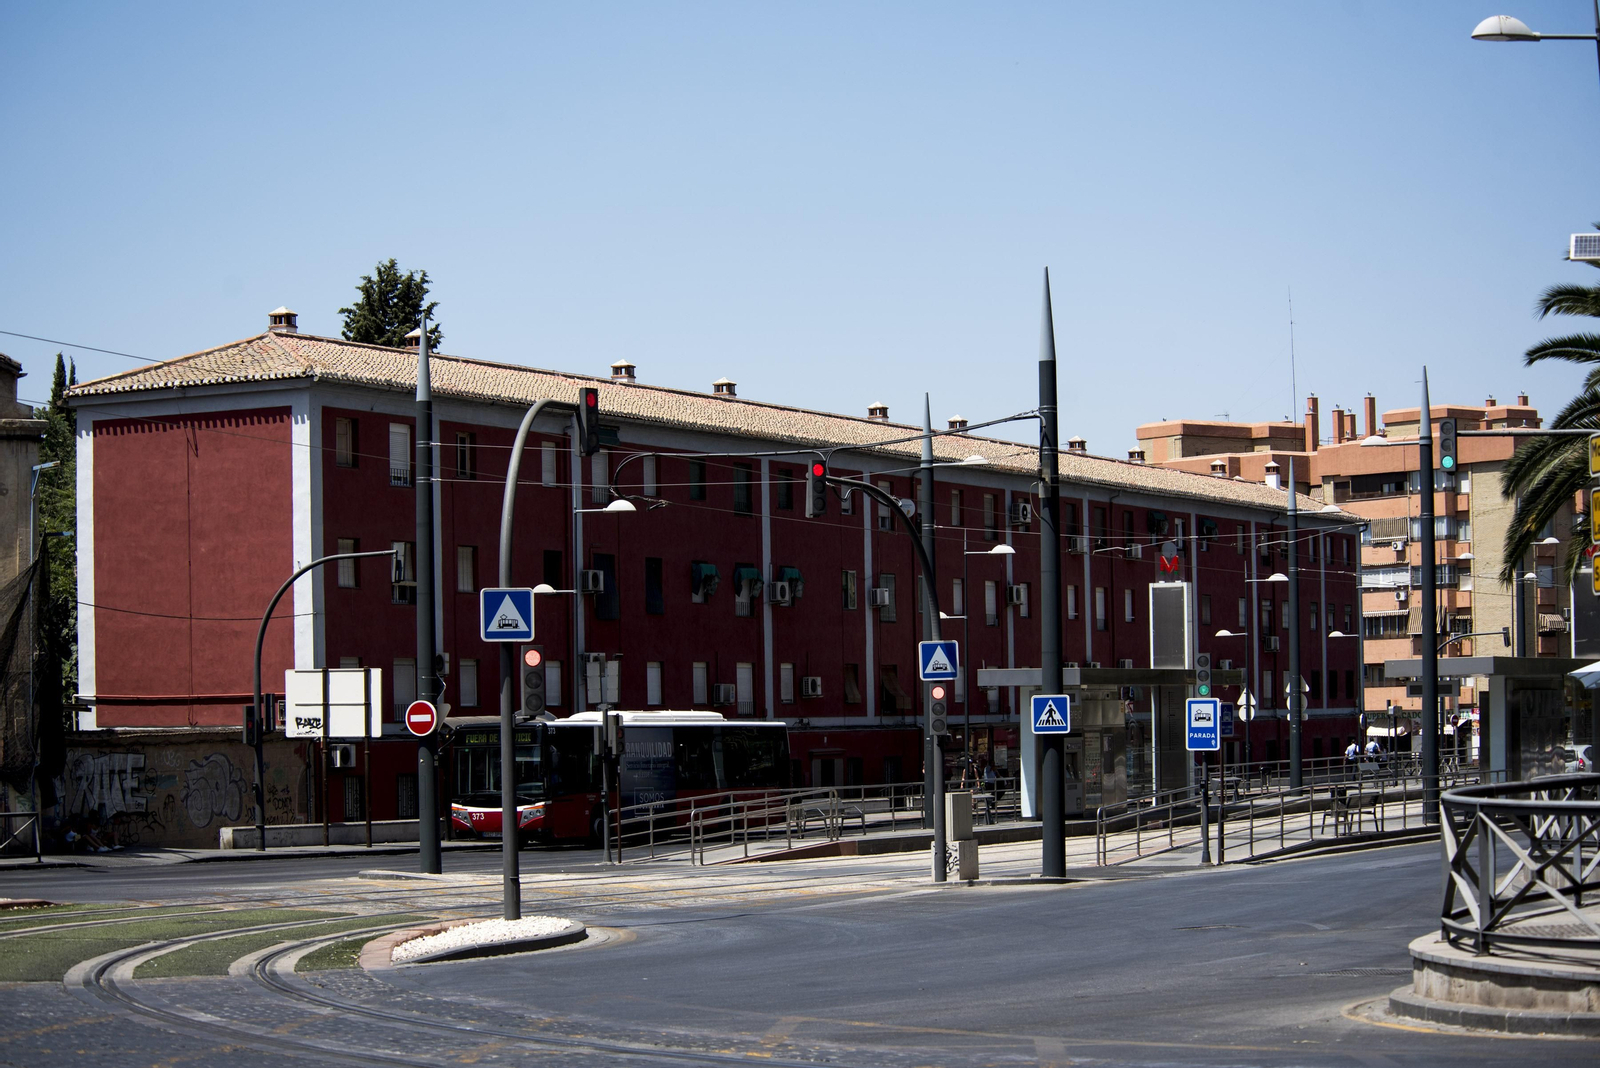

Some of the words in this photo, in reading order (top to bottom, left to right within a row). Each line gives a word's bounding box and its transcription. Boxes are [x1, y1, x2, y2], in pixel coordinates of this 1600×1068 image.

[547, 727, 556, 735] 373
[466, 733, 487, 743] FUERA
[489, 733, 498, 742] DE
[625, 741, 672, 758] RANQUILIDAD
[639, 792, 665, 803] SOMOS
[472, 812, 485, 820] 373
